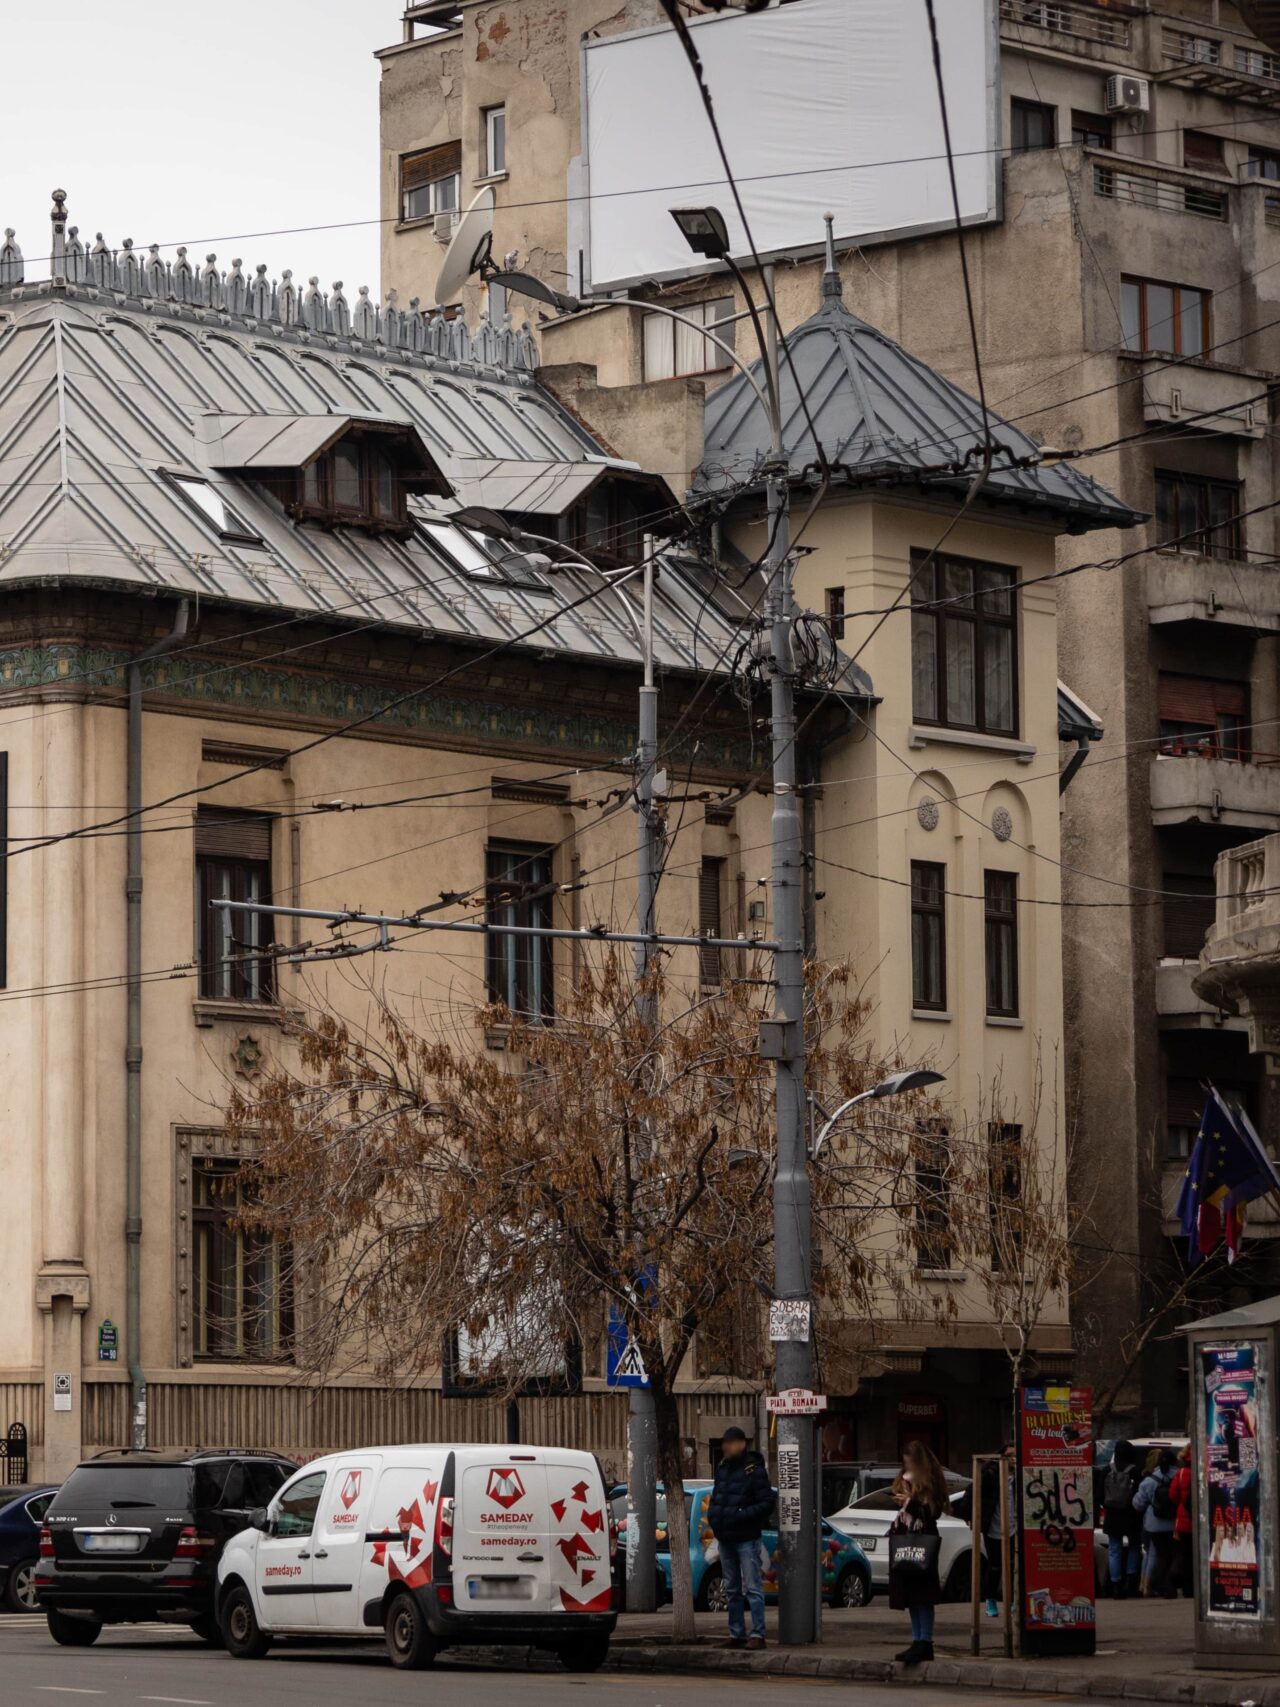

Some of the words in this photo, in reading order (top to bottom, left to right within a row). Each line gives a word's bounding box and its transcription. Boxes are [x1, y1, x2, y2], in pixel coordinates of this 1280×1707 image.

[898, 1403, 938, 1416] SUPERBET
[1026, 1409, 1087, 1429] BUCHAREST
[1031, 1427, 1047, 1440] city
[787, 1450, 800, 1490] DAMIAN
[791, 1497, 800, 1507] 28
[333, 1514, 359, 1523] SAMEDAY
[480, 1513, 533, 1523] SAMEDAY
[791, 1509, 800, 1525] MAI
[480, 1537, 537, 1547] sameday.ro
[265, 1564, 302, 1577] sameday.ro
